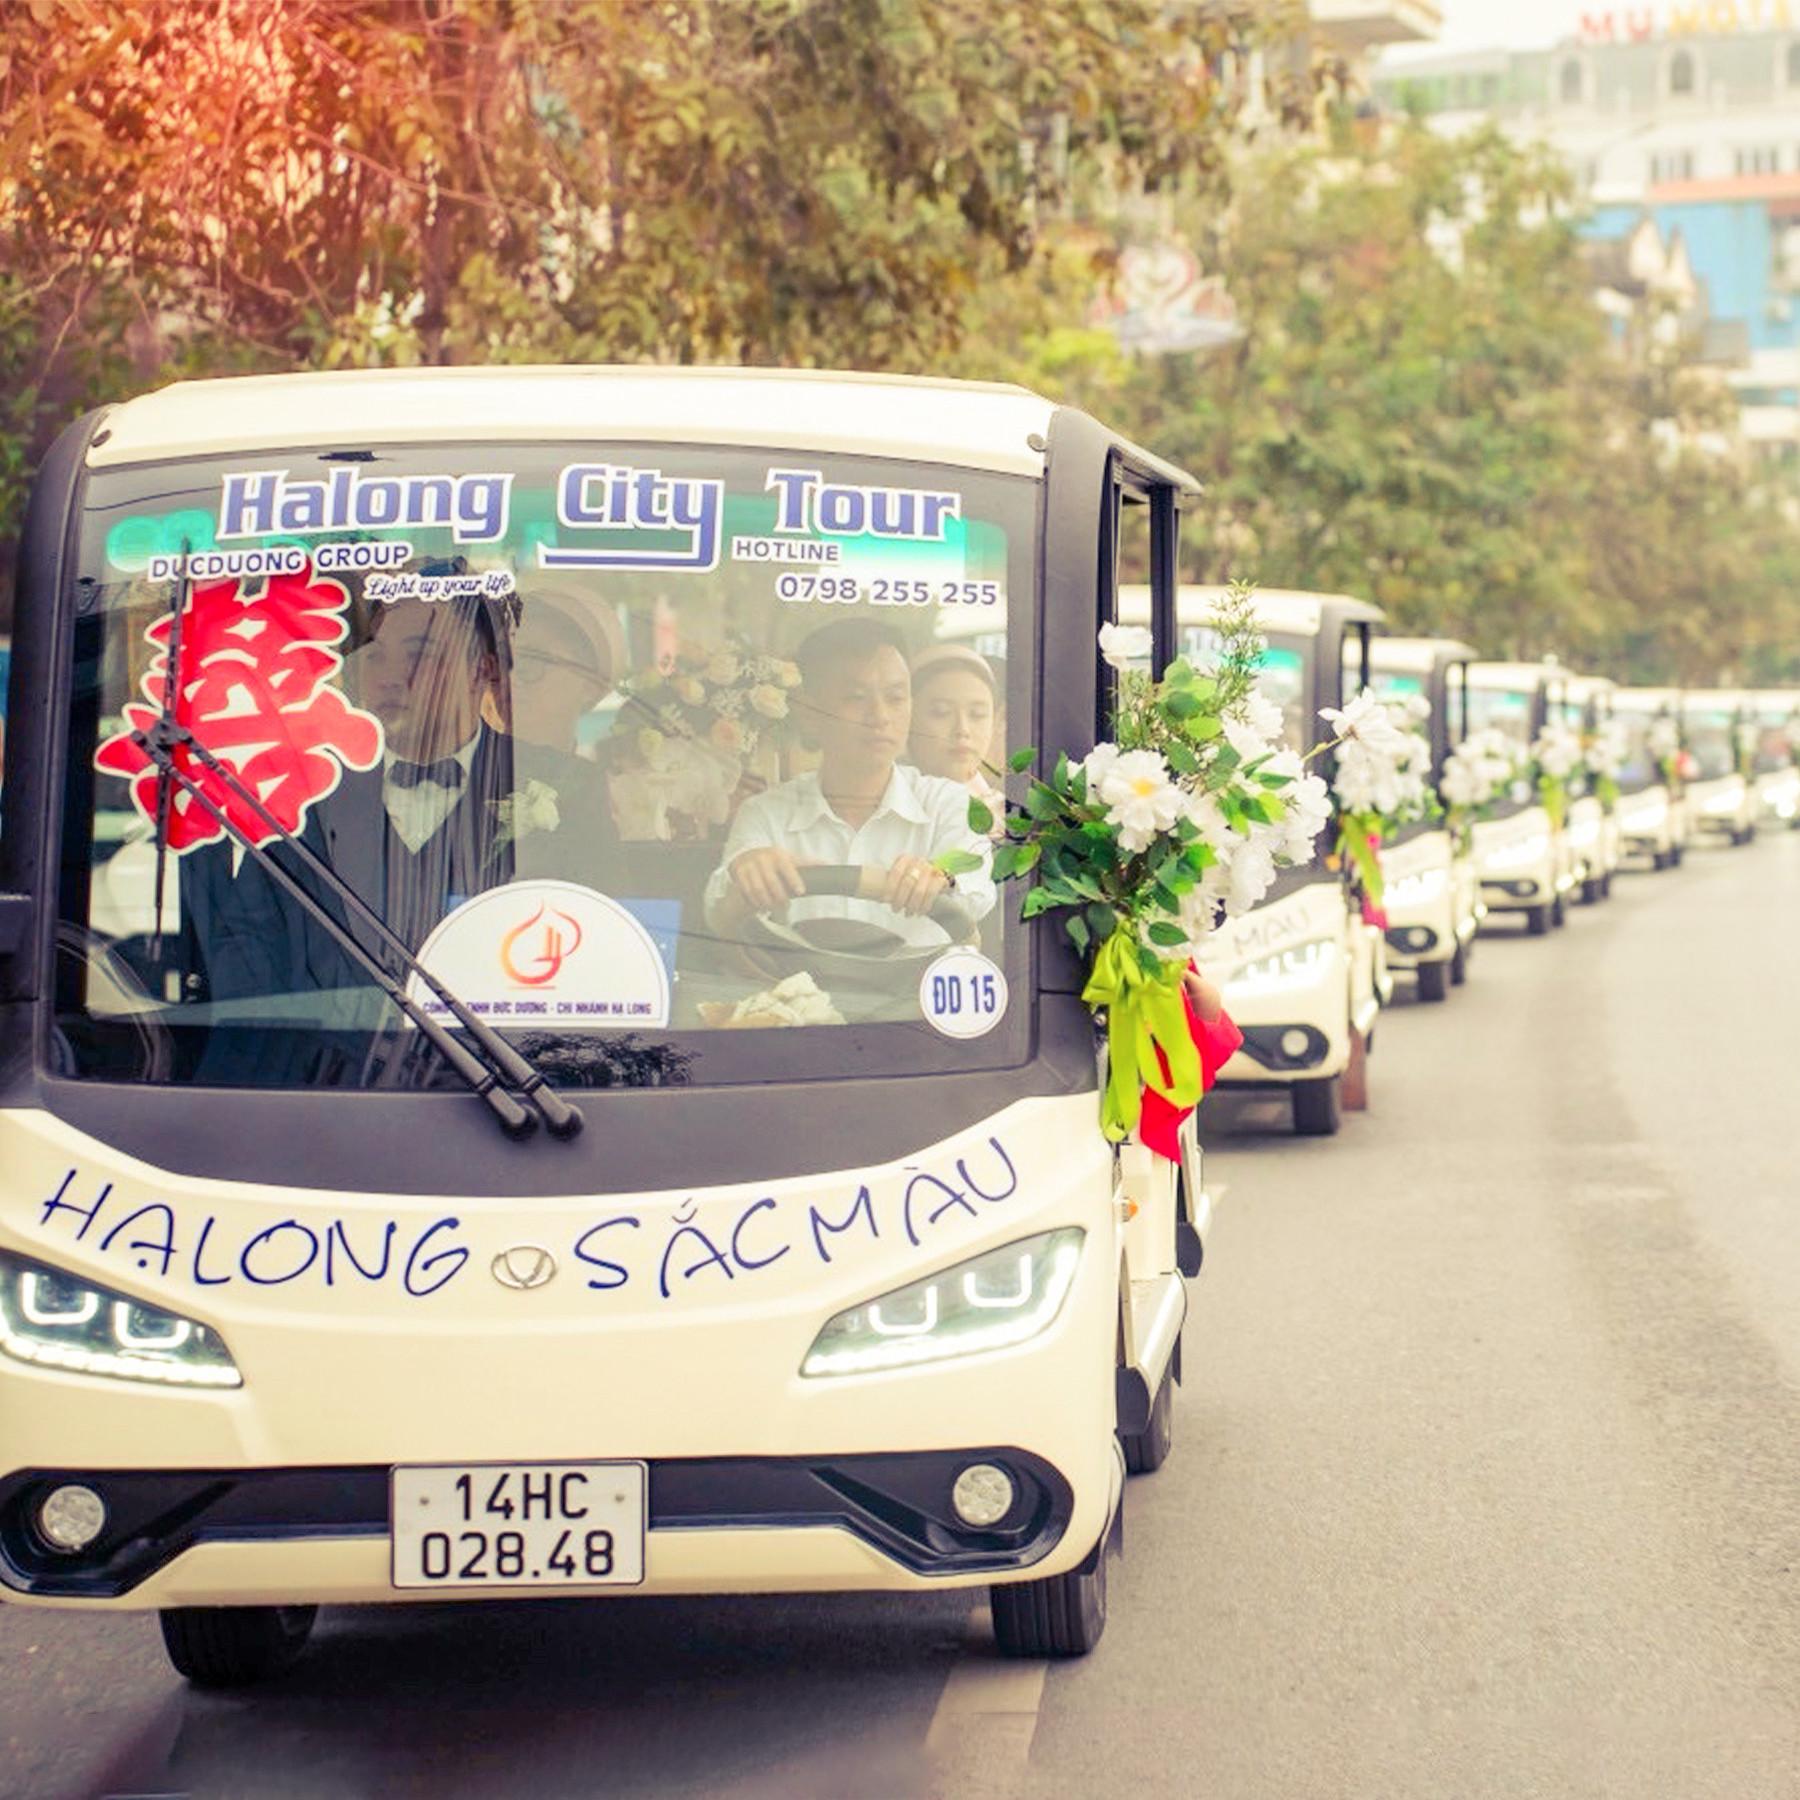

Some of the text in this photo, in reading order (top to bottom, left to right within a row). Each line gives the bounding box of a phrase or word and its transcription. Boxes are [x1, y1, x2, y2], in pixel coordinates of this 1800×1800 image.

[218, 464, 960, 571] Halong City Tour
[152, 546, 409, 578] DUCDUONG GROUP
[735, 540, 840, 562] HOTLINE
[370, 573, 512, 598] Light up your life
[780, 574, 997, 605] 0798 255 255
[933, 974, 996, 1015] ĐD 15
[455, 1472, 589, 1521] 14HC
[421, 1529, 614, 1579] 028.48
